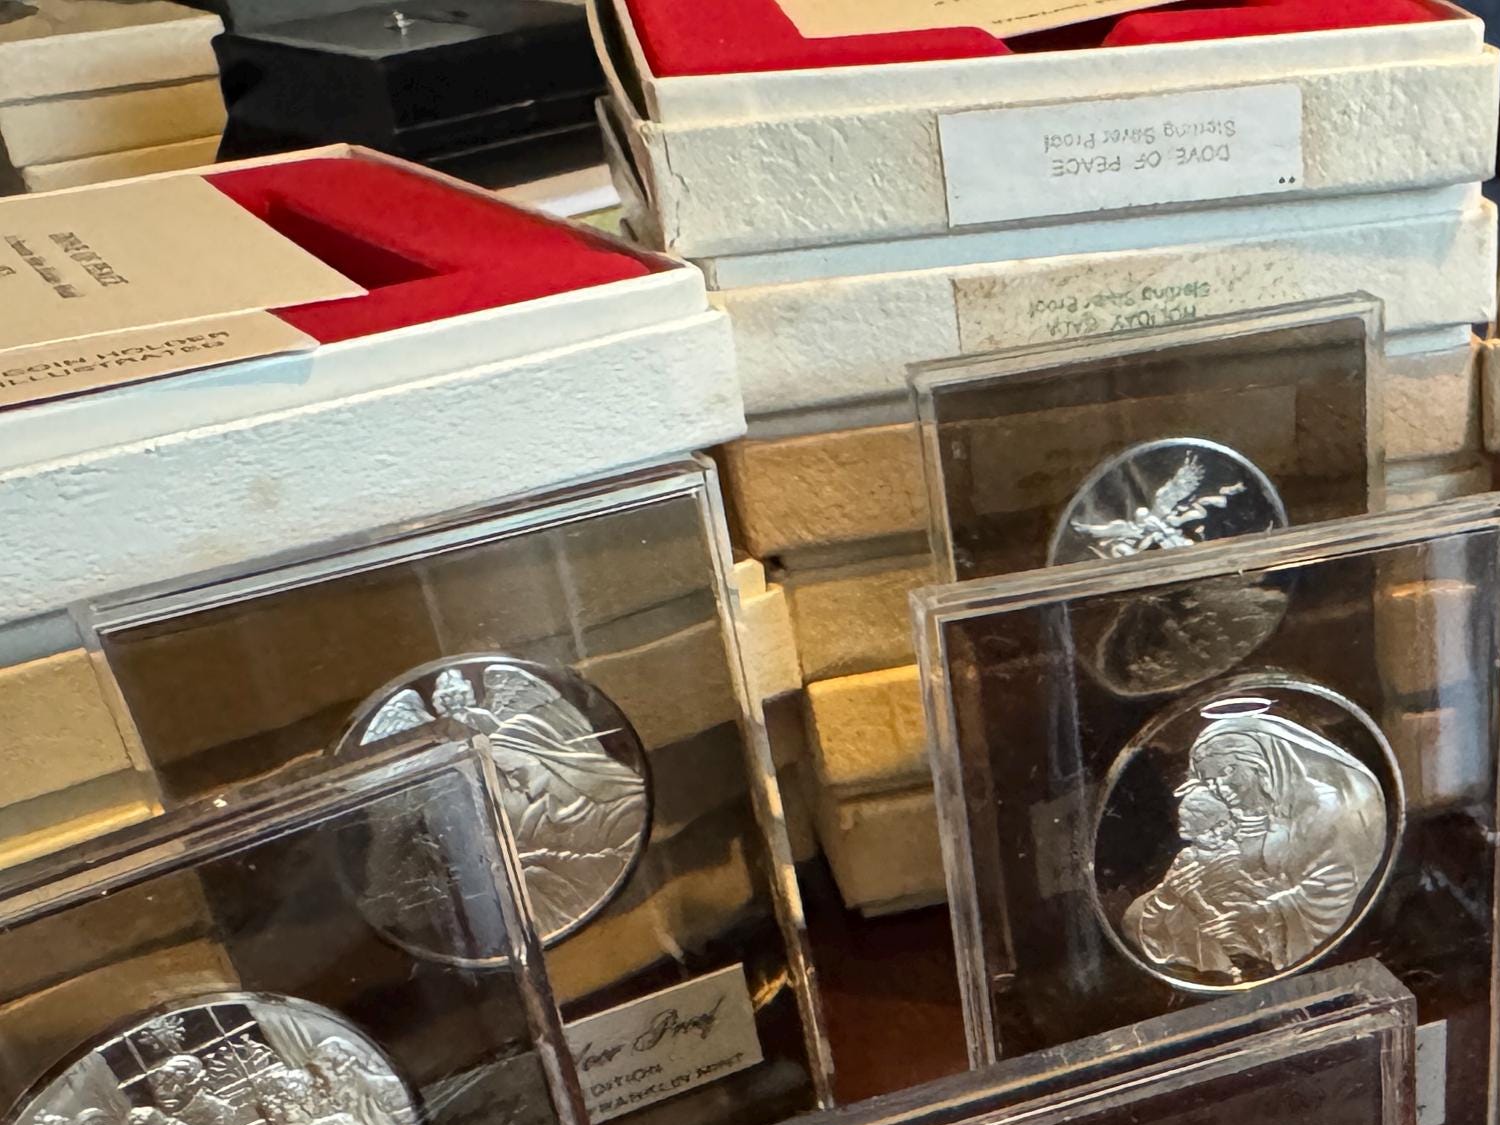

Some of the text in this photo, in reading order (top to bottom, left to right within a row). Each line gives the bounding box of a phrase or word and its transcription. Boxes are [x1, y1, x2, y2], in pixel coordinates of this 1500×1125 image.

[1052, 143, 1232, 177] DOVE OF PEACE
[1, 330, 231, 377] COIN HOLDER
[632, 992, 728, 1053] Proof
[590, 1063, 664, 1097] DITION
